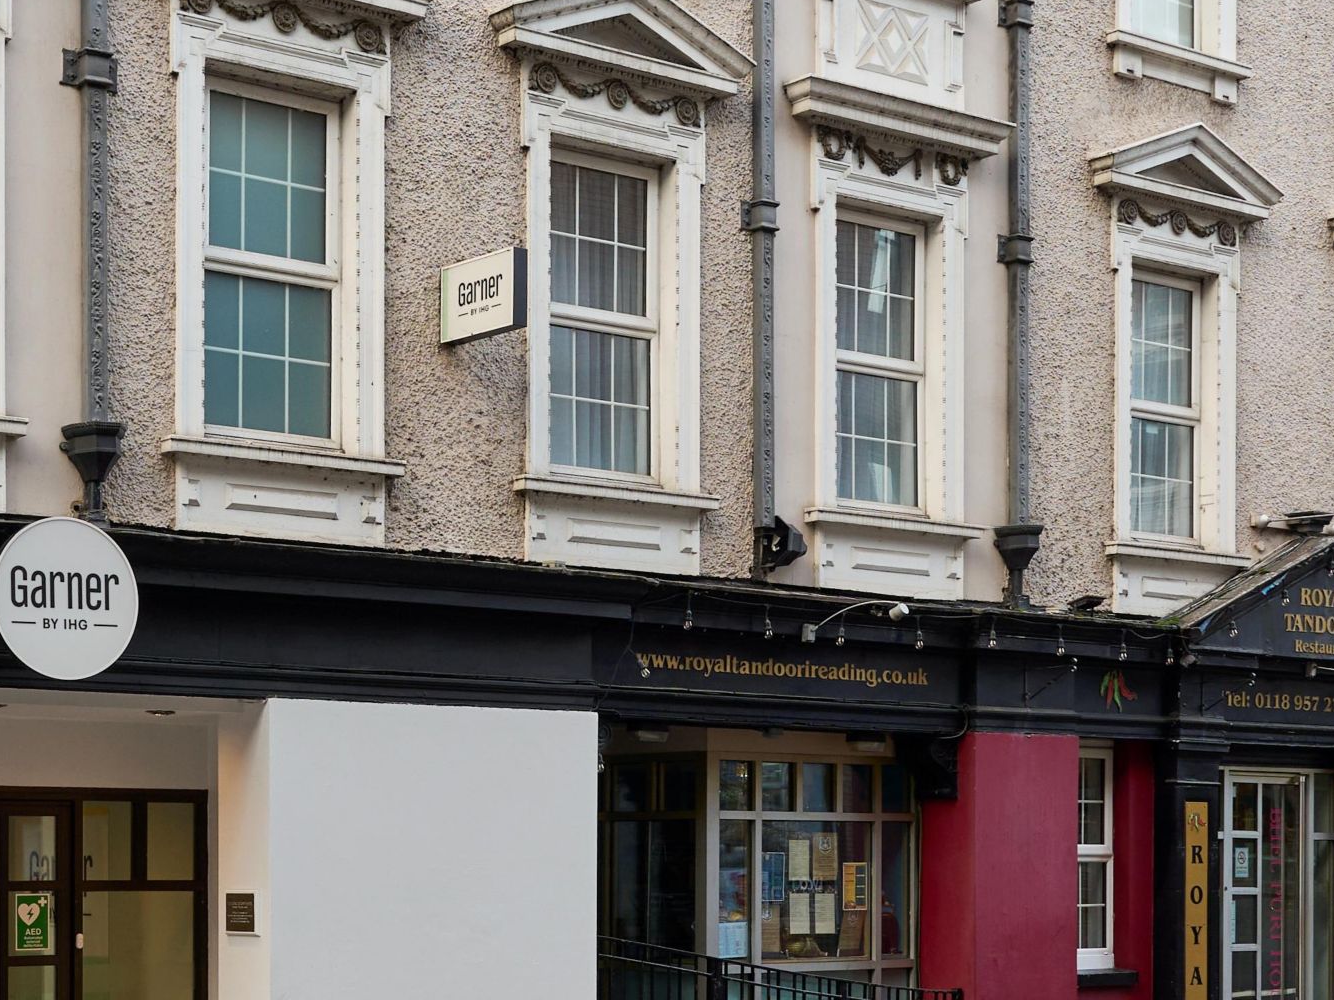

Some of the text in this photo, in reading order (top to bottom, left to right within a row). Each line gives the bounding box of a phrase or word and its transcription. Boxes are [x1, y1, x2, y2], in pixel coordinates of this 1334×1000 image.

[457, 273, 503, 307] Garner
[470, 304, 490, 316] BY IHG
[10, 565, 120, 611] Garner
[43, 618, 88, 630] BY IHG
[636, 653, 928, 687] www.royaltandoorireading.co.uk
[1223, 690, 1250, 708] Tel:
[1255, 692, 1290, 710] 0118
[1294, 695, 1320, 712] 957
[1190, 845, 1204, 985] ROYA
[25, 927, 42, 936] AED
